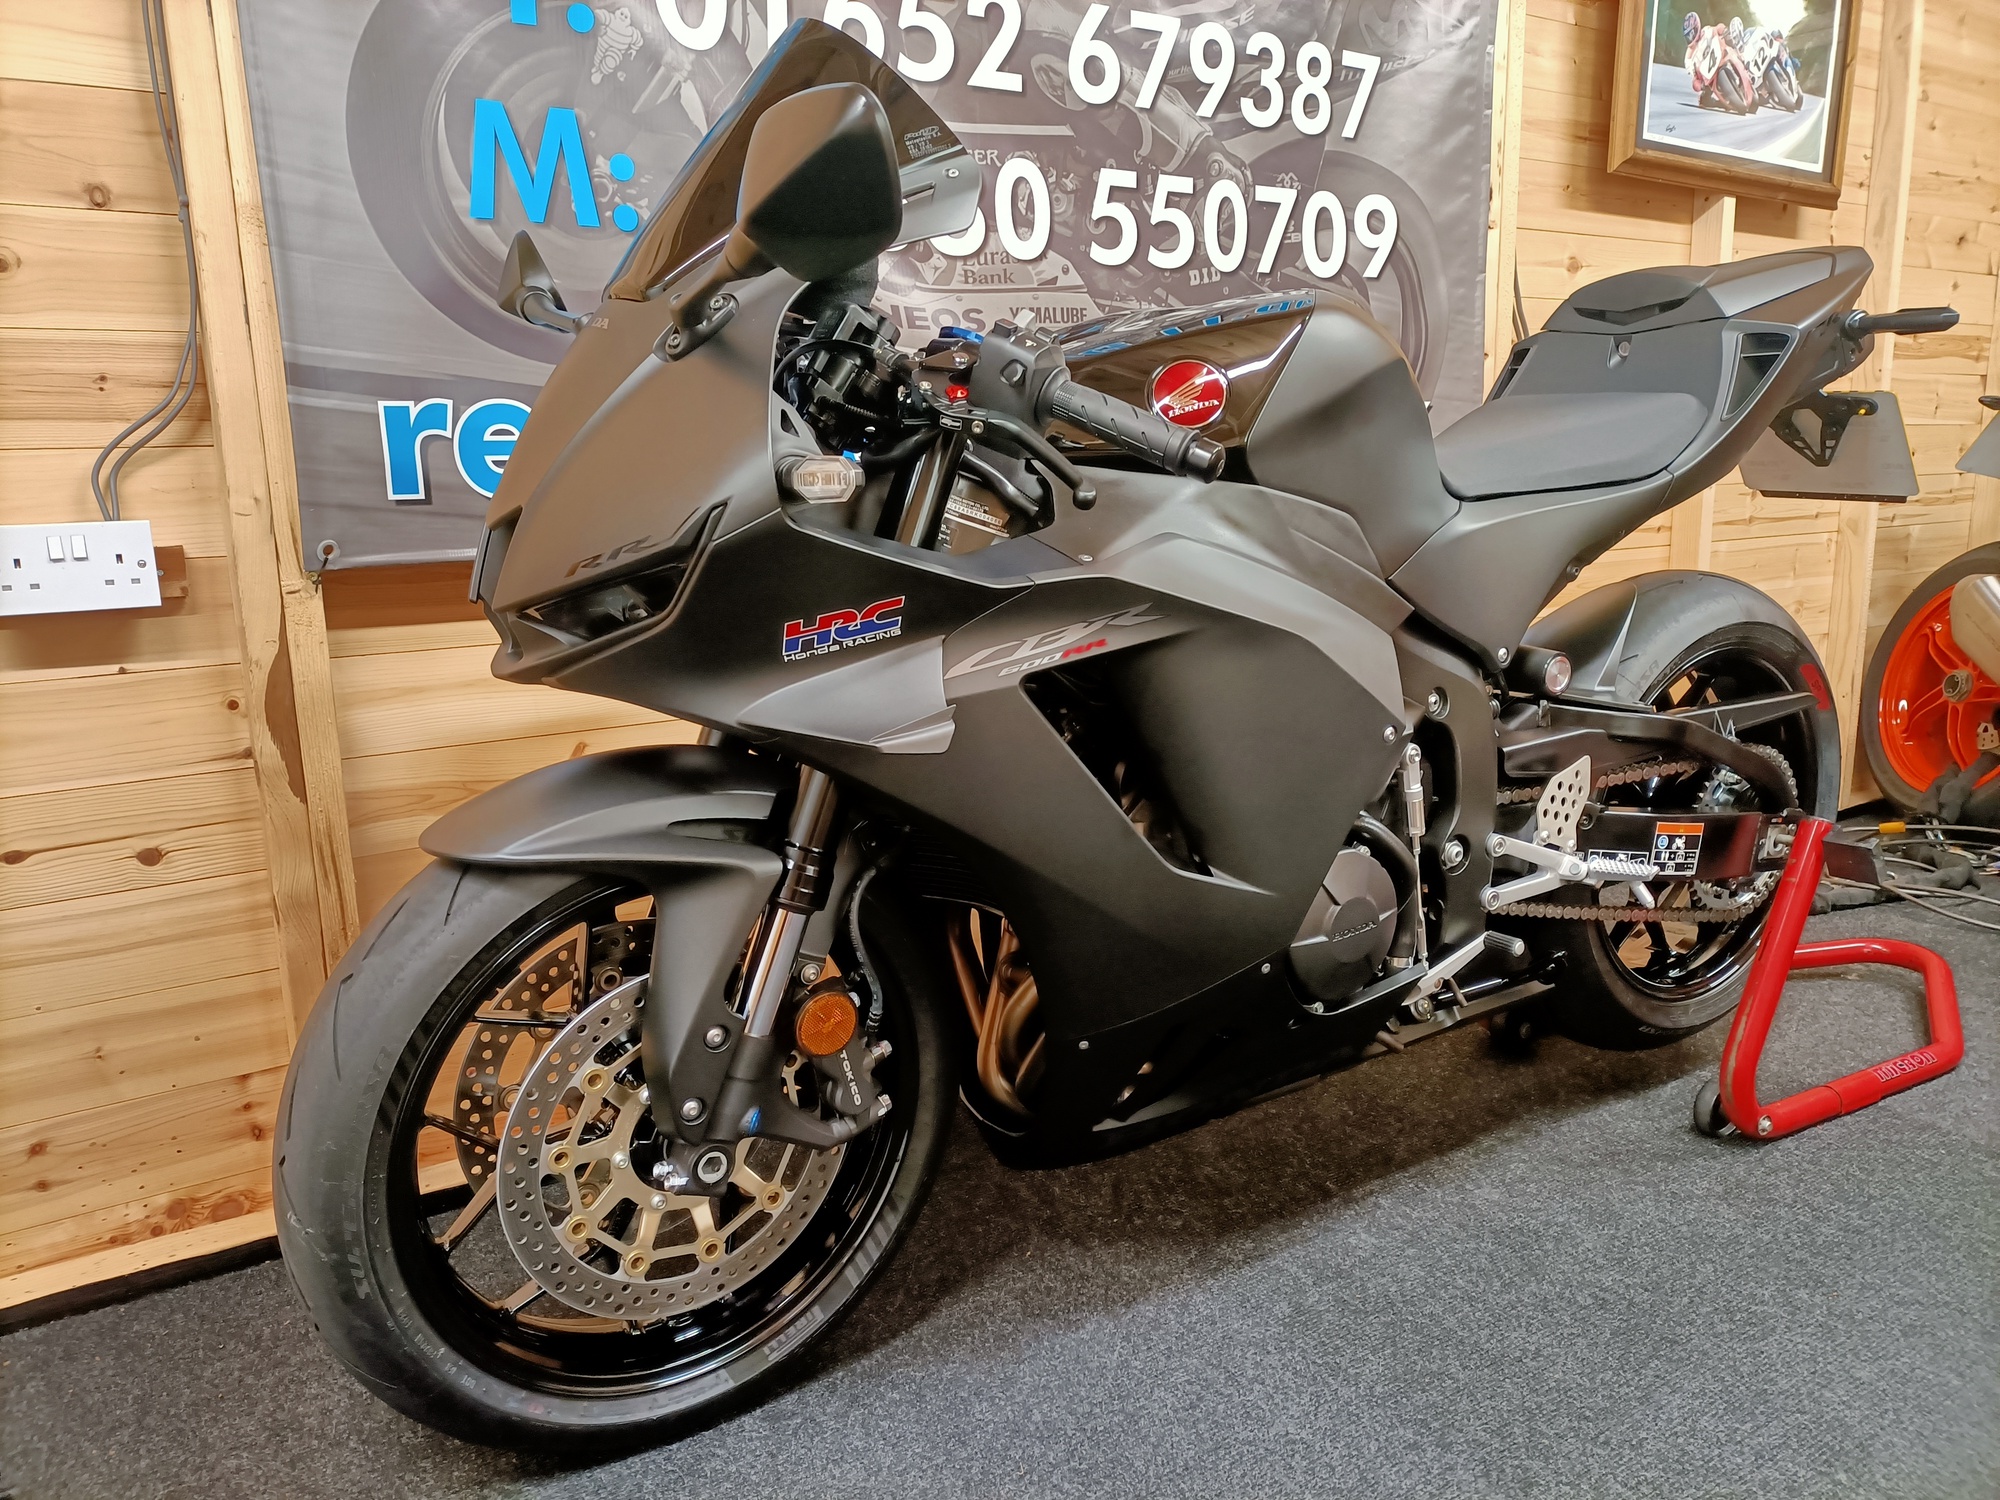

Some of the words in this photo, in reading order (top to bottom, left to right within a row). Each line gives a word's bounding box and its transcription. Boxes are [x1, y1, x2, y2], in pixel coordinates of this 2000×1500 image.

[1068, 3, 1381, 139] 679387
[470, 98, 639, 232] M:
[1089, 167, 1398, 279] 550709
[962, 268, 1016, 285] Bank
[1167, 399, 1220, 419] HONDA
[782, 595, 906, 656] HRC
[843, 628, 902, 649] RACING
[944, 602, 1172, 680] CBR
[840, 1049, 862, 1106] TOKICO
[763, 1304, 825, 1361] PIRELLI
